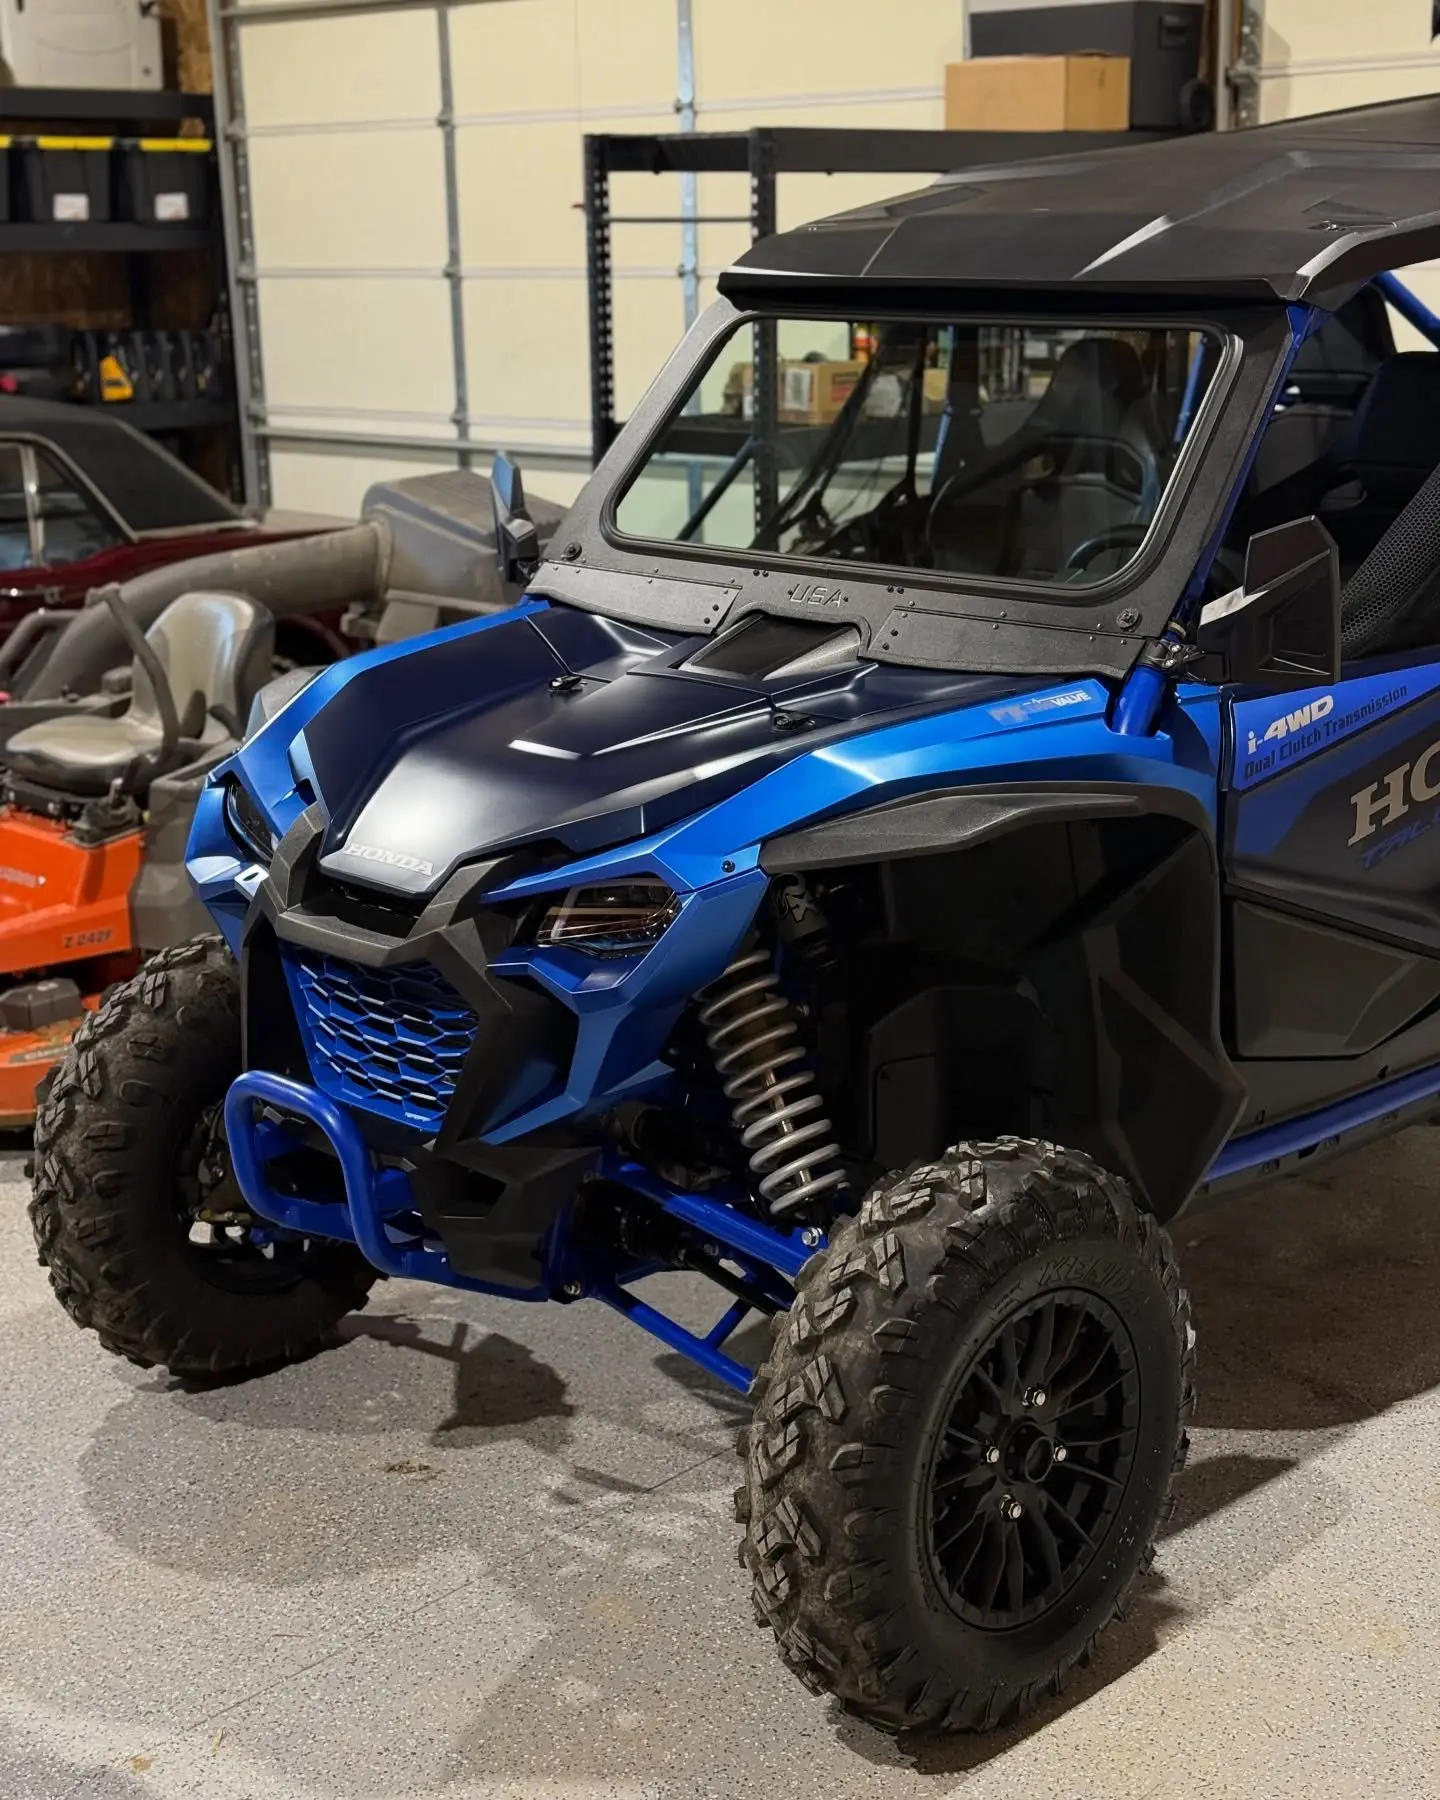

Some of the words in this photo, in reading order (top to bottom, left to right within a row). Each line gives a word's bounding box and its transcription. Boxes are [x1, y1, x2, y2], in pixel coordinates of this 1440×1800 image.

[789, 583, 842, 608] USA
[1051, 690, 1093, 707] VALVE
[1244, 752, 1277, 780] Dual
[1279, 727, 1322, 760] Clutch
[1323, 685, 1409, 738] Transmission
[1247, 694, 1334, 755] i-4WD
[342, 841, 435, 877] HONDA
[63, 936, 74, 949] Z
